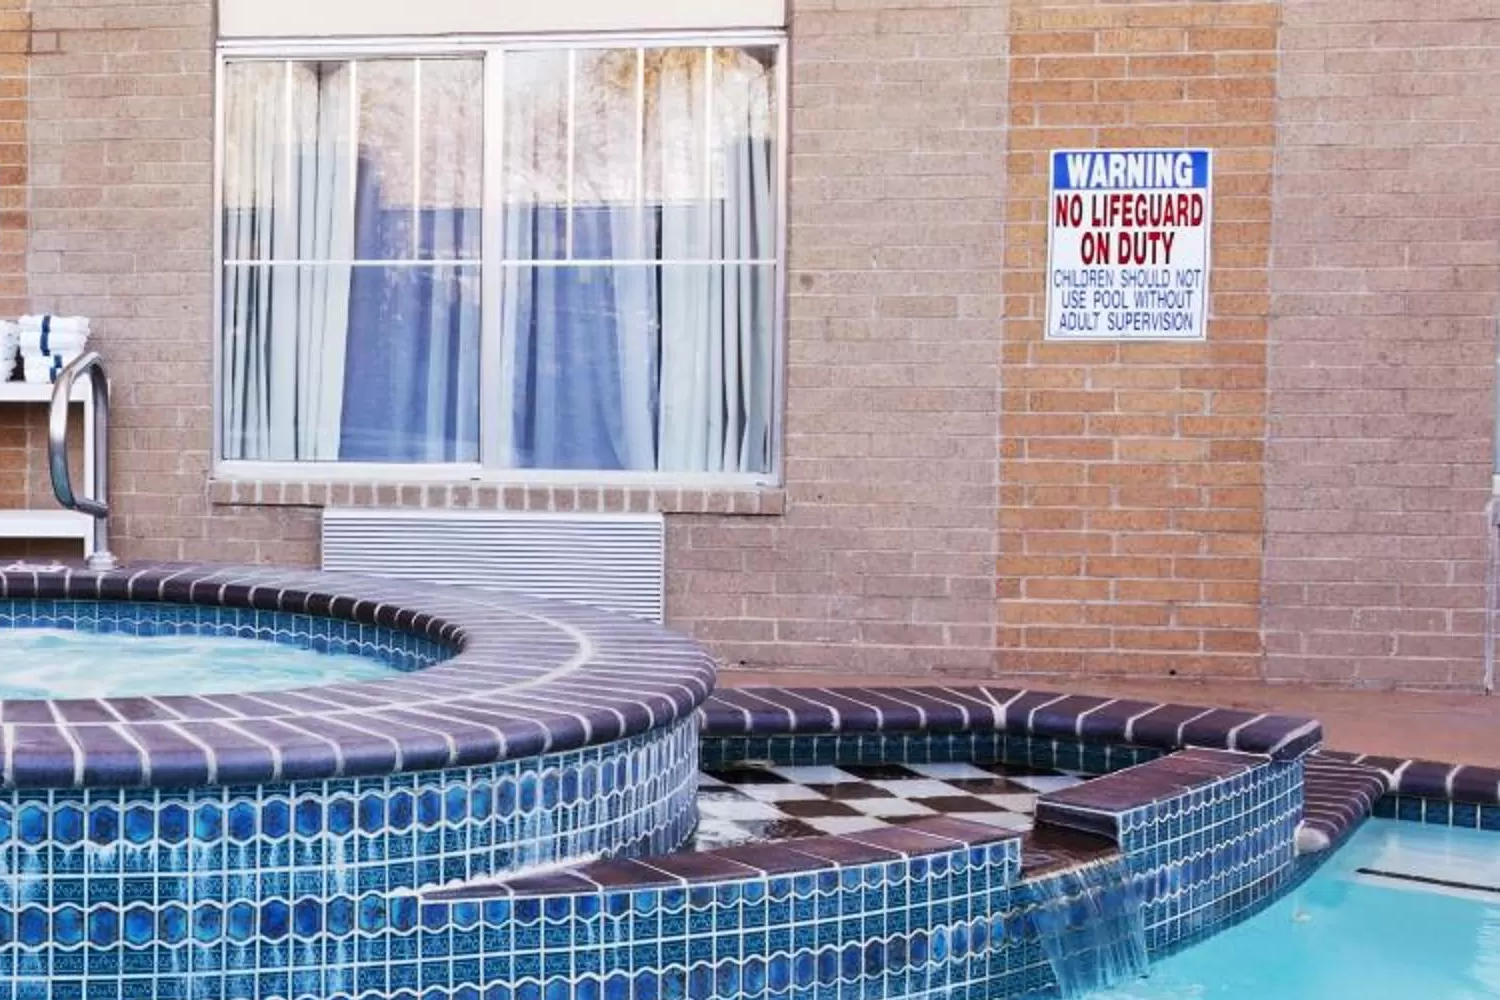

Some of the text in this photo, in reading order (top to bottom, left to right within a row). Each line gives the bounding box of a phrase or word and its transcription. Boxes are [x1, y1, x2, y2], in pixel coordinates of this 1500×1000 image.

[1066, 153, 1193, 188] WARNING
[1056, 193, 1204, 228] NO LIFEGUARD
[1081, 231, 1175, 265] ON DUTY
[1054, 269, 1202, 288] CHILDREN SHOULD NOT
[1061, 290, 1194, 309] USE POOL WITHOUT
[1059, 312, 1194, 331] ADULT SUPERVISION
